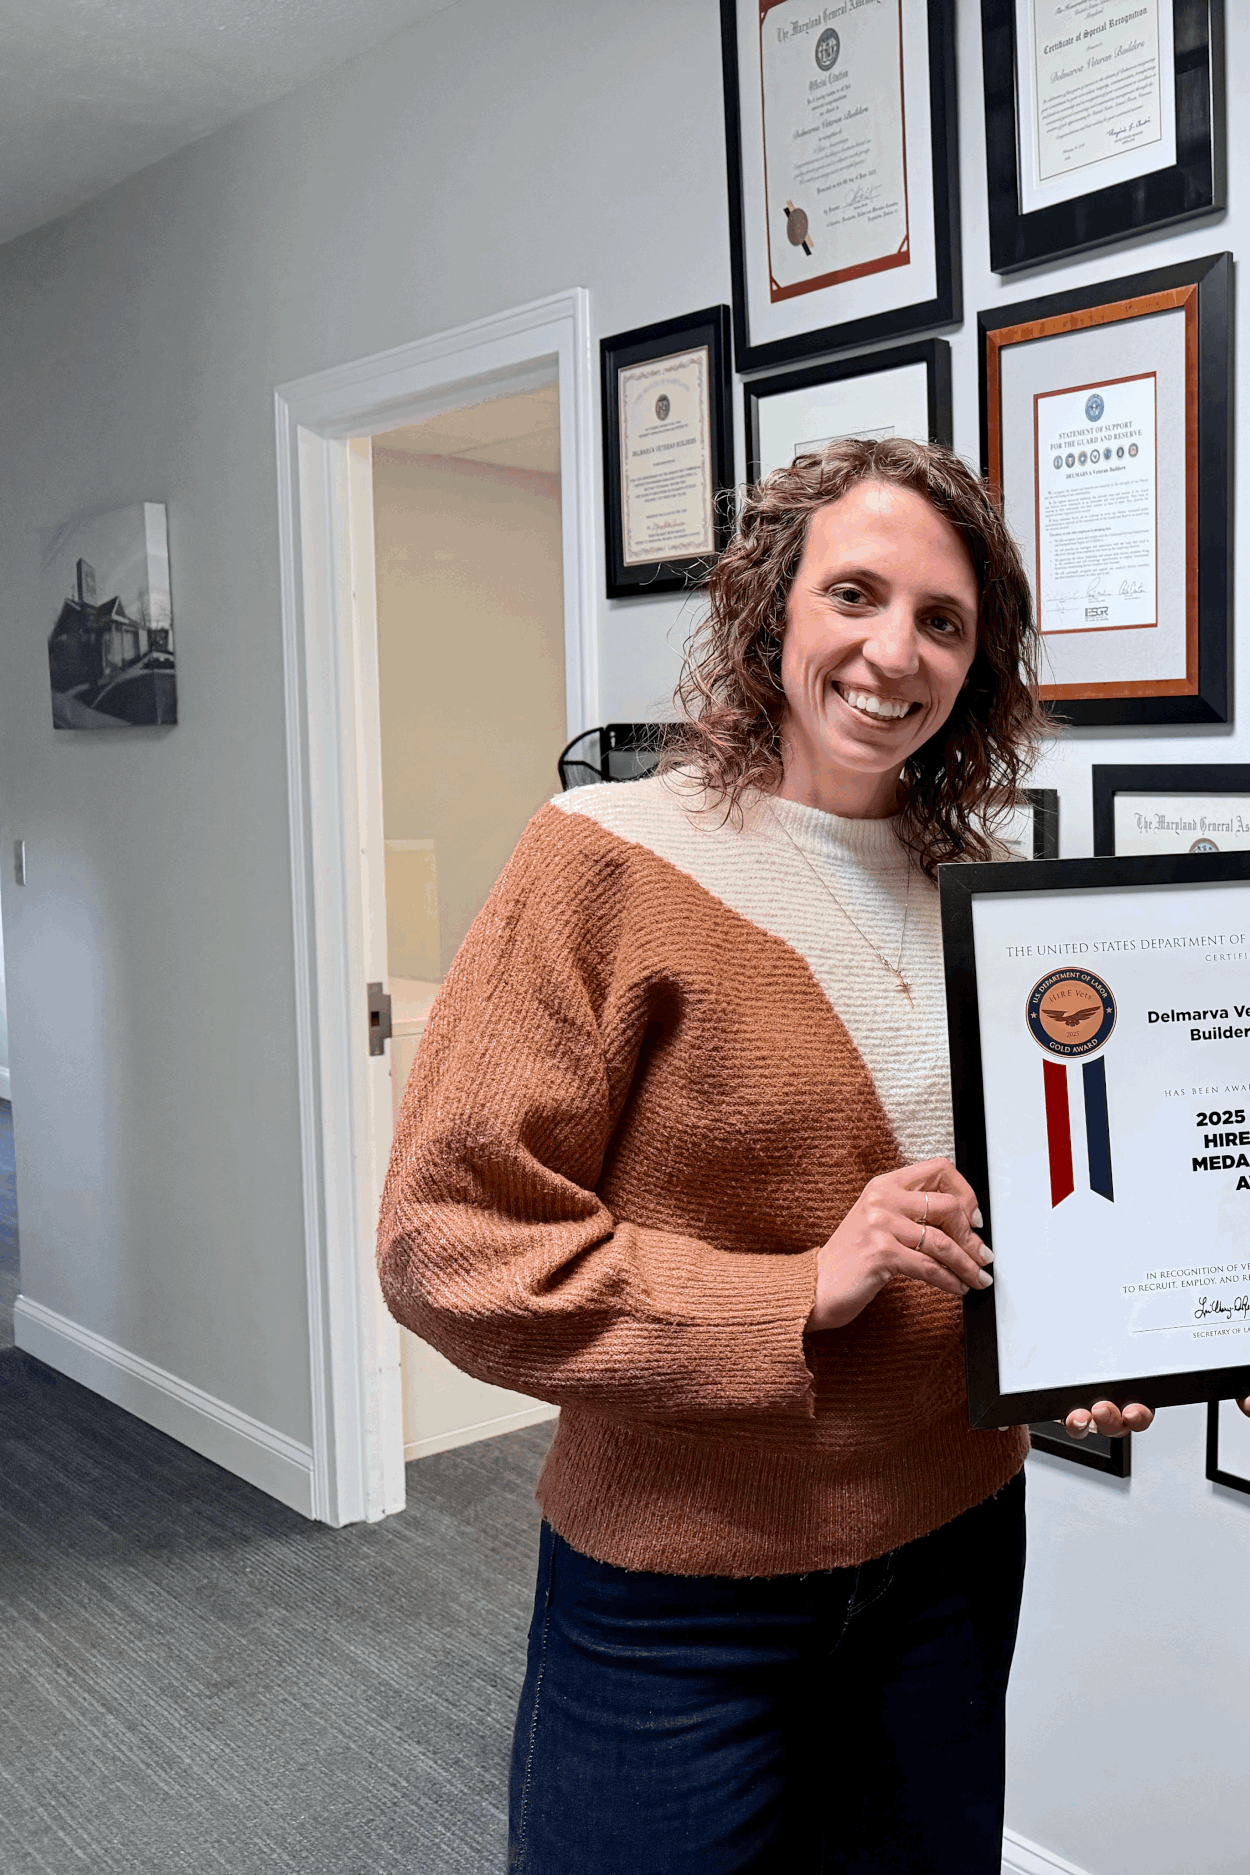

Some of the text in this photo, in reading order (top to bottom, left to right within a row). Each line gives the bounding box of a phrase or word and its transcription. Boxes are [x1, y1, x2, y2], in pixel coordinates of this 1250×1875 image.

[1044, 37, 1074, 54] Certificate
[1076, 32, 1081, 42] of
[1083, 22, 1106, 39] Special
[1109, 7, 1147, 29] Recognition
[1059, 428, 1094, 440] STATEMENT
[1105, 421, 1132, 432] SUPPORT
[1064, 440, 1075, 449] THE
[1077, 437, 1098, 447] GUARD
[1100, 434, 1112, 443] AND
[1114, 429, 1142, 440] RESERVE
[1134, 812, 1153, 834] The
[1154, 813, 1197, 835] Maryland
[1200, 816, 1233, 835] General
[1006, 944, 1034, 958] THE
[1037, 942, 1089, 956] UNITED
[1093, 940, 1136, 953] STATES
[1140, 934, 1226, 950] DEPARTMENT
[1229, 934, 1246, 944] OF
[1032, 972, 1108, 1003] U.S. DEPARTMENT OF LABOR
[1049, 989, 1092, 1002] HIRE Vets
[1148, 1008, 1229, 1024] Delmarva
[1049, 1039, 1098, 1053] GOLD AWARD
[1164, 1088, 1186, 1097] HAS
[1192, 1086, 1219, 1095] BEEN
[1196, 1109, 1246, 1127] 2025
[1204, 1131, 1250, 1148] HIRE
[1146, 1272, 1157, 1280] IN
[1160, 1265, 1224, 1279] RECOGNITION
[1227, 1263, 1238, 1271] OF
[1123, 1285, 1135, 1294] TO
[1138, 1282, 1178, 1292] RECRUIT,
[1181, 1277, 1217, 1288] EMPLOY,
[1219, 1275, 1239, 1284] AND
[1193, 1329, 1230, 1339] SECRETARY
